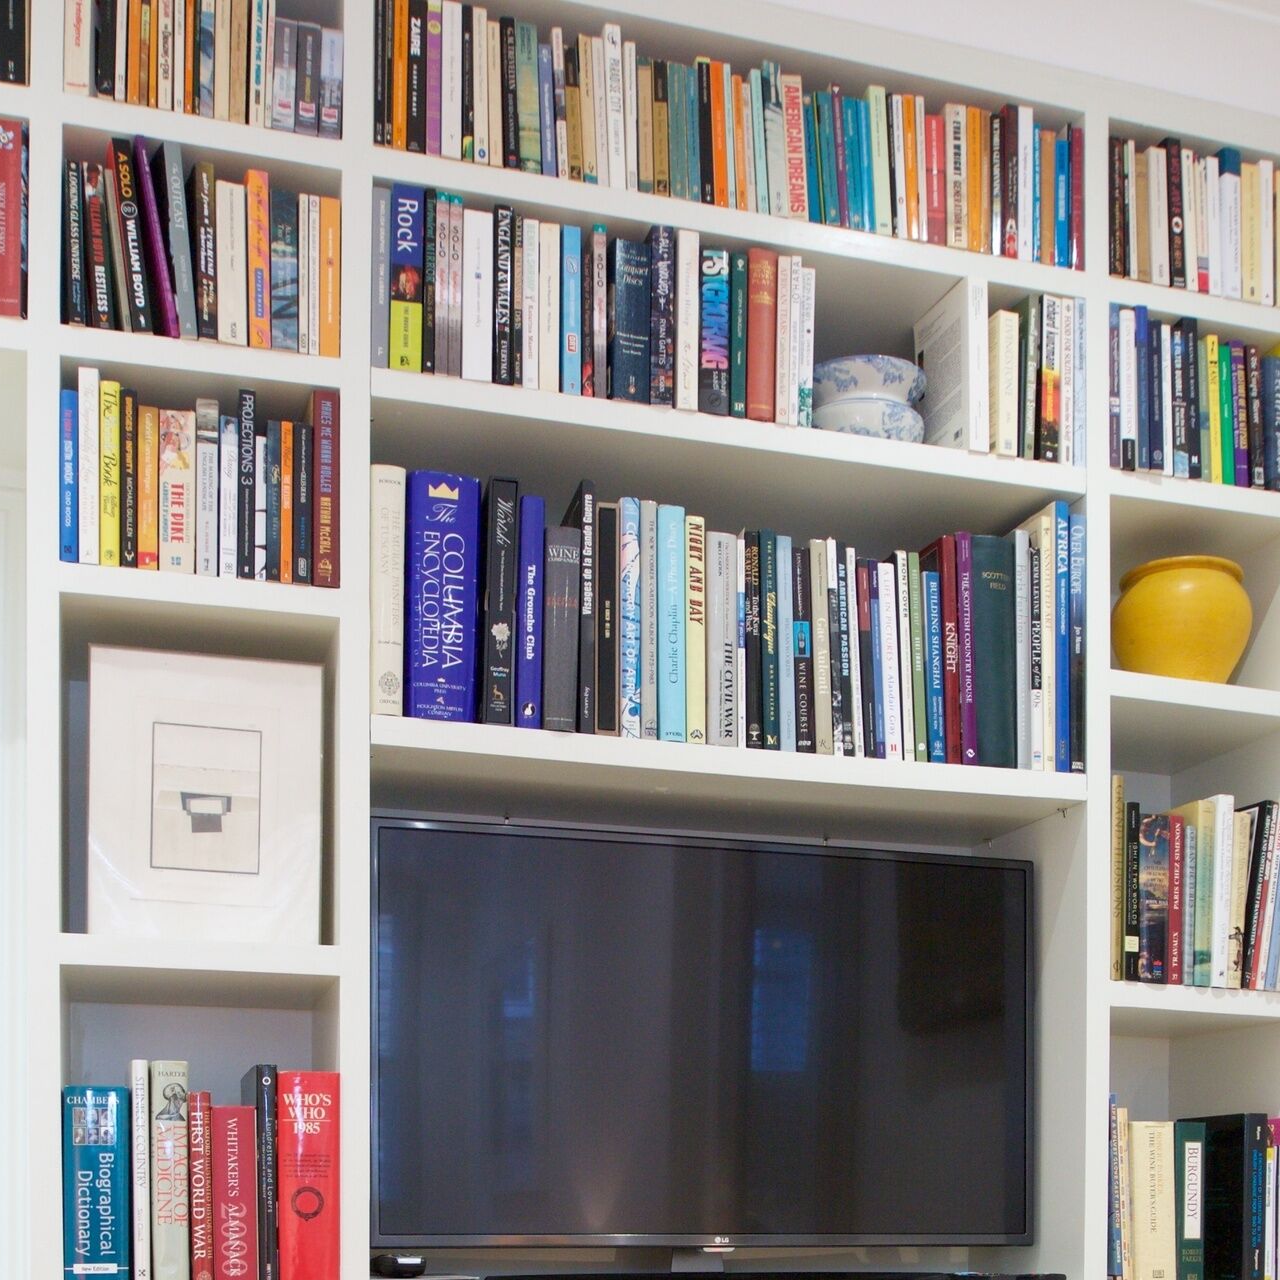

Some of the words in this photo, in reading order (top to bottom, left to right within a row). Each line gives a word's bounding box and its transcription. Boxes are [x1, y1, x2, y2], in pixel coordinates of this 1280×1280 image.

[410, 17, 421, 56] ZAIRE
[784, 85, 804, 154] AMERICAN
[952, 121, 961, 142] EVAN
[117, 152, 128, 163] A
[953, 144, 962, 176] WRIGHT
[69, 171, 79, 209] LOOKING
[119, 164, 132, 198] SOLO
[788, 157, 805, 212] DREAMS
[89, 197, 101, 235] WILLIAM
[171, 176, 184, 230] OUTCAST
[953, 180, 961, 225] GENERATION
[70, 211, 79, 237] GLASS
[397, 198, 418, 254] Rock
[498, 209, 511, 270] ENGLAND
[70, 239, 81, 280] UNIVERSE
[91, 237, 103, 262] BOYD
[126, 220, 142, 271] WILLIAM
[95, 265, 108, 312] RESTLESS
[131, 274, 145, 307] BOYD
[500, 340, 508, 379] EVERYMAN
[568, 336, 576, 352] DRY
[1174, 346, 1182, 367] FILTER
[321, 400, 332, 425] MAKES
[241, 394, 253, 472] PROJECTIONS
[321, 427, 332, 438] ME
[321, 439, 332, 464] WANNA
[170, 483, 184, 510] THE
[241, 476, 252, 486] 3
[321, 466, 332, 493] HOLLER
[170, 513, 184, 544] PIKE
[321, 496, 332, 525] NATHAN
[425, 503, 456, 523] The
[496, 497, 514, 545] Wartski
[548, 548, 580, 558] WINE
[688, 522, 703, 561] NIGHT
[1057, 518, 1068, 574] AFRICA
[1070, 525, 1085, 555] OVER
[527, 565, 536, 585] The
[689, 566, 703, 593] AND
[839, 563, 846, 577] AN
[962, 572, 970, 590] THE
[1070, 557, 1085, 594] EUROPE
[421, 530, 441, 667] ENCYCLOPEDIA
[441, 533, 465, 669] COLUMBIA
[526, 587, 536, 632] Groucho
[689, 600, 703, 625] DAY
[839, 580, 847, 630] AMERICAN
[929, 581, 938, 633] BUILDING
[963, 591, 971, 632] SCOTTISH
[667, 605, 678, 644] Chaplin
[761, 591, 776, 655] Champagne
[1032, 620, 1041, 664] PEOPLE
[526, 636, 535, 660] Club
[668, 647, 678, 684] Charlie
[724, 642, 733, 667] THE
[841, 634, 849, 676] PASSION
[931, 636, 940, 689] SHANGHAI
[945, 622, 956, 673] KNIGHT
[963, 633, 972, 673] COUNTRY
[724, 670, 733, 705] CIVIL
[799, 662, 807, 690] WINE
[965, 675, 973, 704] HOUSE
[1033, 666, 1041, 675] of
[799, 693, 808, 733] COURSE
[1032, 692, 1041, 708] 90s
[724, 707, 733, 738] WAR
[1132, 860, 1137, 870] IN
[283, 1093, 332, 1106] WHO'S
[288, 1107, 326, 1120] WHO
[191, 1112, 205, 1153] FIRST
[293, 1122, 320, 1135] 1985
[137, 1135, 147, 1189] COUNTRY
[173, 1125, 187, 1196] IMAGES
[227, 1118, 240, 1197] WHITAKER'S
[156, 1127, 172, 1227] MEDICINE
[192, 1158, 204, 1219] WORLD
[1186, 1147, 1199, 1219] BURGUNDY
[75, 1170, 92, 1256] Dictionary
[95, 1153, 115, 1256] Biographical
[174, 1203, 187, 1228] OF
[193, 1225, 205, 1260] WAR
[220, 1202, 248, 1277] 2000
[228, 1203, 241, 1277] ALMANACK
